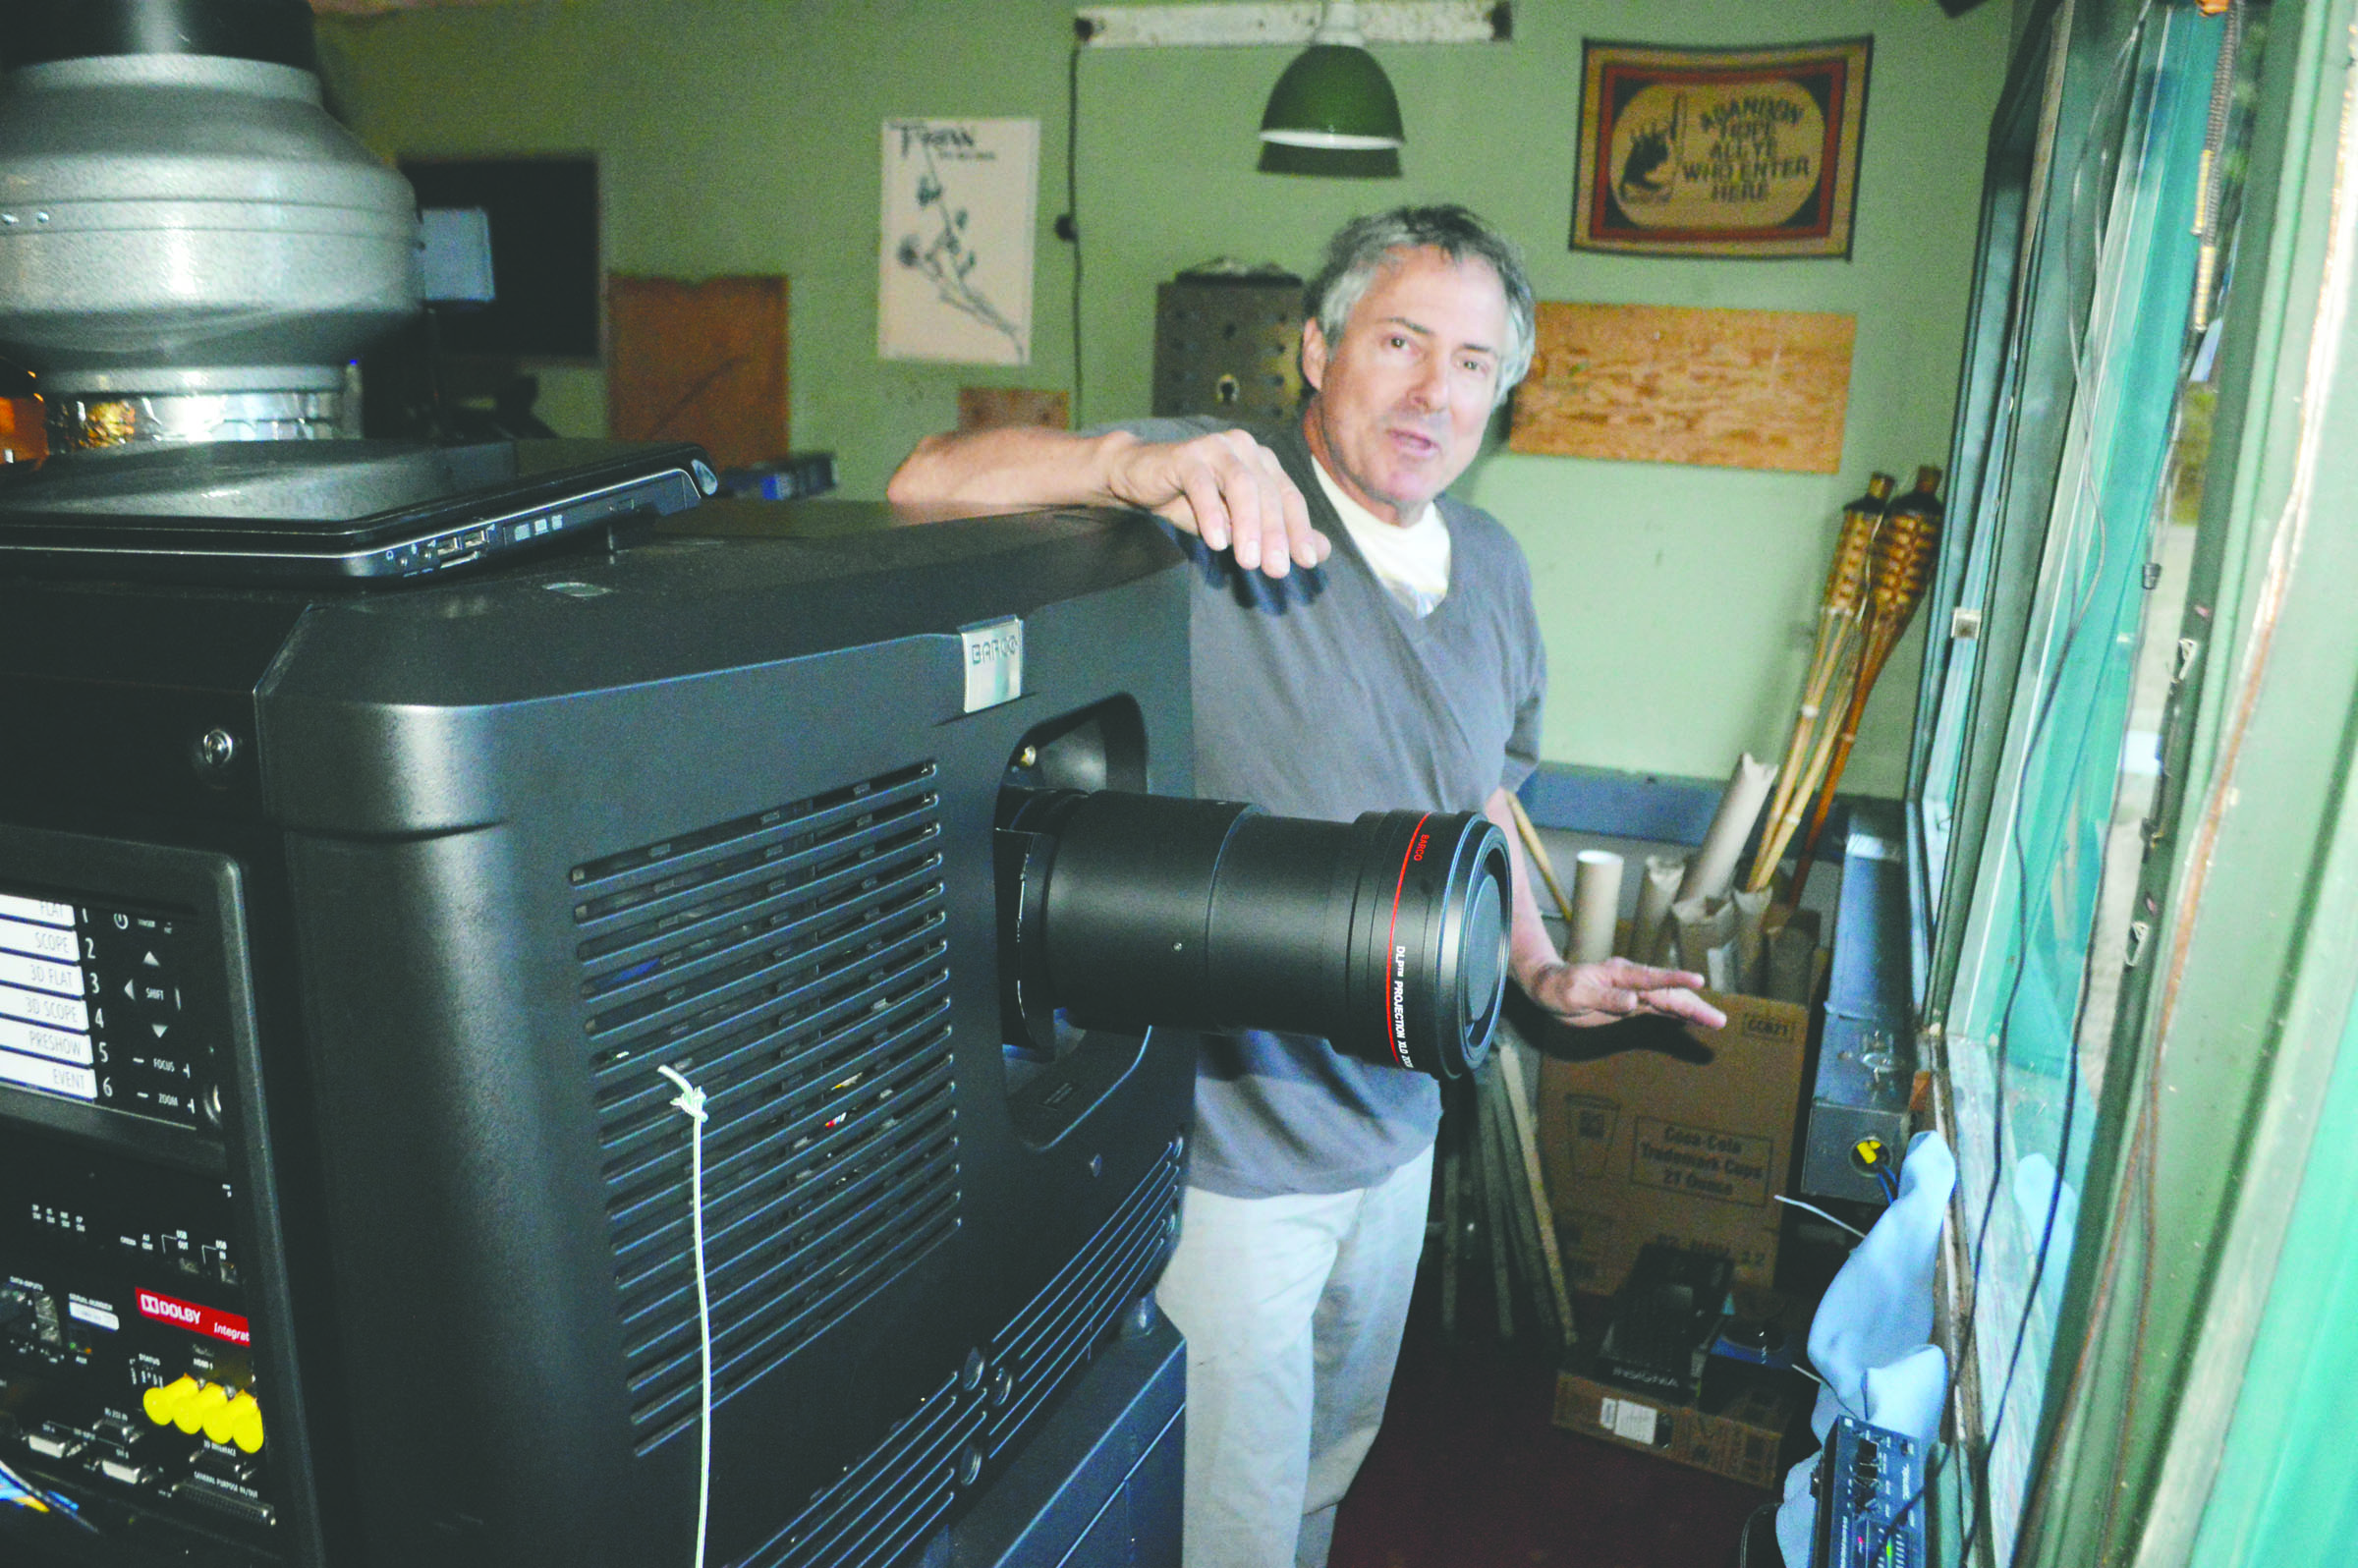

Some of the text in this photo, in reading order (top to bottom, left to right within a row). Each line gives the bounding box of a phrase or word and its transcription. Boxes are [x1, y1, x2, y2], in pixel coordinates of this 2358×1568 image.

[971, 635, 1017, 664] BARCO
[1413, 834, 1431, 862] BARCO
[35, 931, 70, 954] SCOPE
[84, 937, 96, 960] 2
[29, 965, 73, 987] 3D FLAT
[89, 973, 100, 994] 3
[145, 987, 164, 1001] SHIFT
[26, 996, 78, 1023] 3D SCOPE
[94, 1008, 105, 1029] 4
[1393, 980, 1405, 1038] PROJECTION
[29, 1031, 82, 1058] PRESHOW
[98, 1041, 109, 1063] 5
[1398, 1040, 1409, 1055] XLD
[153, 1057, 175, 1073] FOCUS
[52, 1068, 85, 1092] EVENT
[102, 1077, 113, 1097] 6
[158, 1092, 179, 1107] ZOOM
[159, 1300, 201, 1324] DOLBY
[213, 1322, 250, 1342] Integrat
